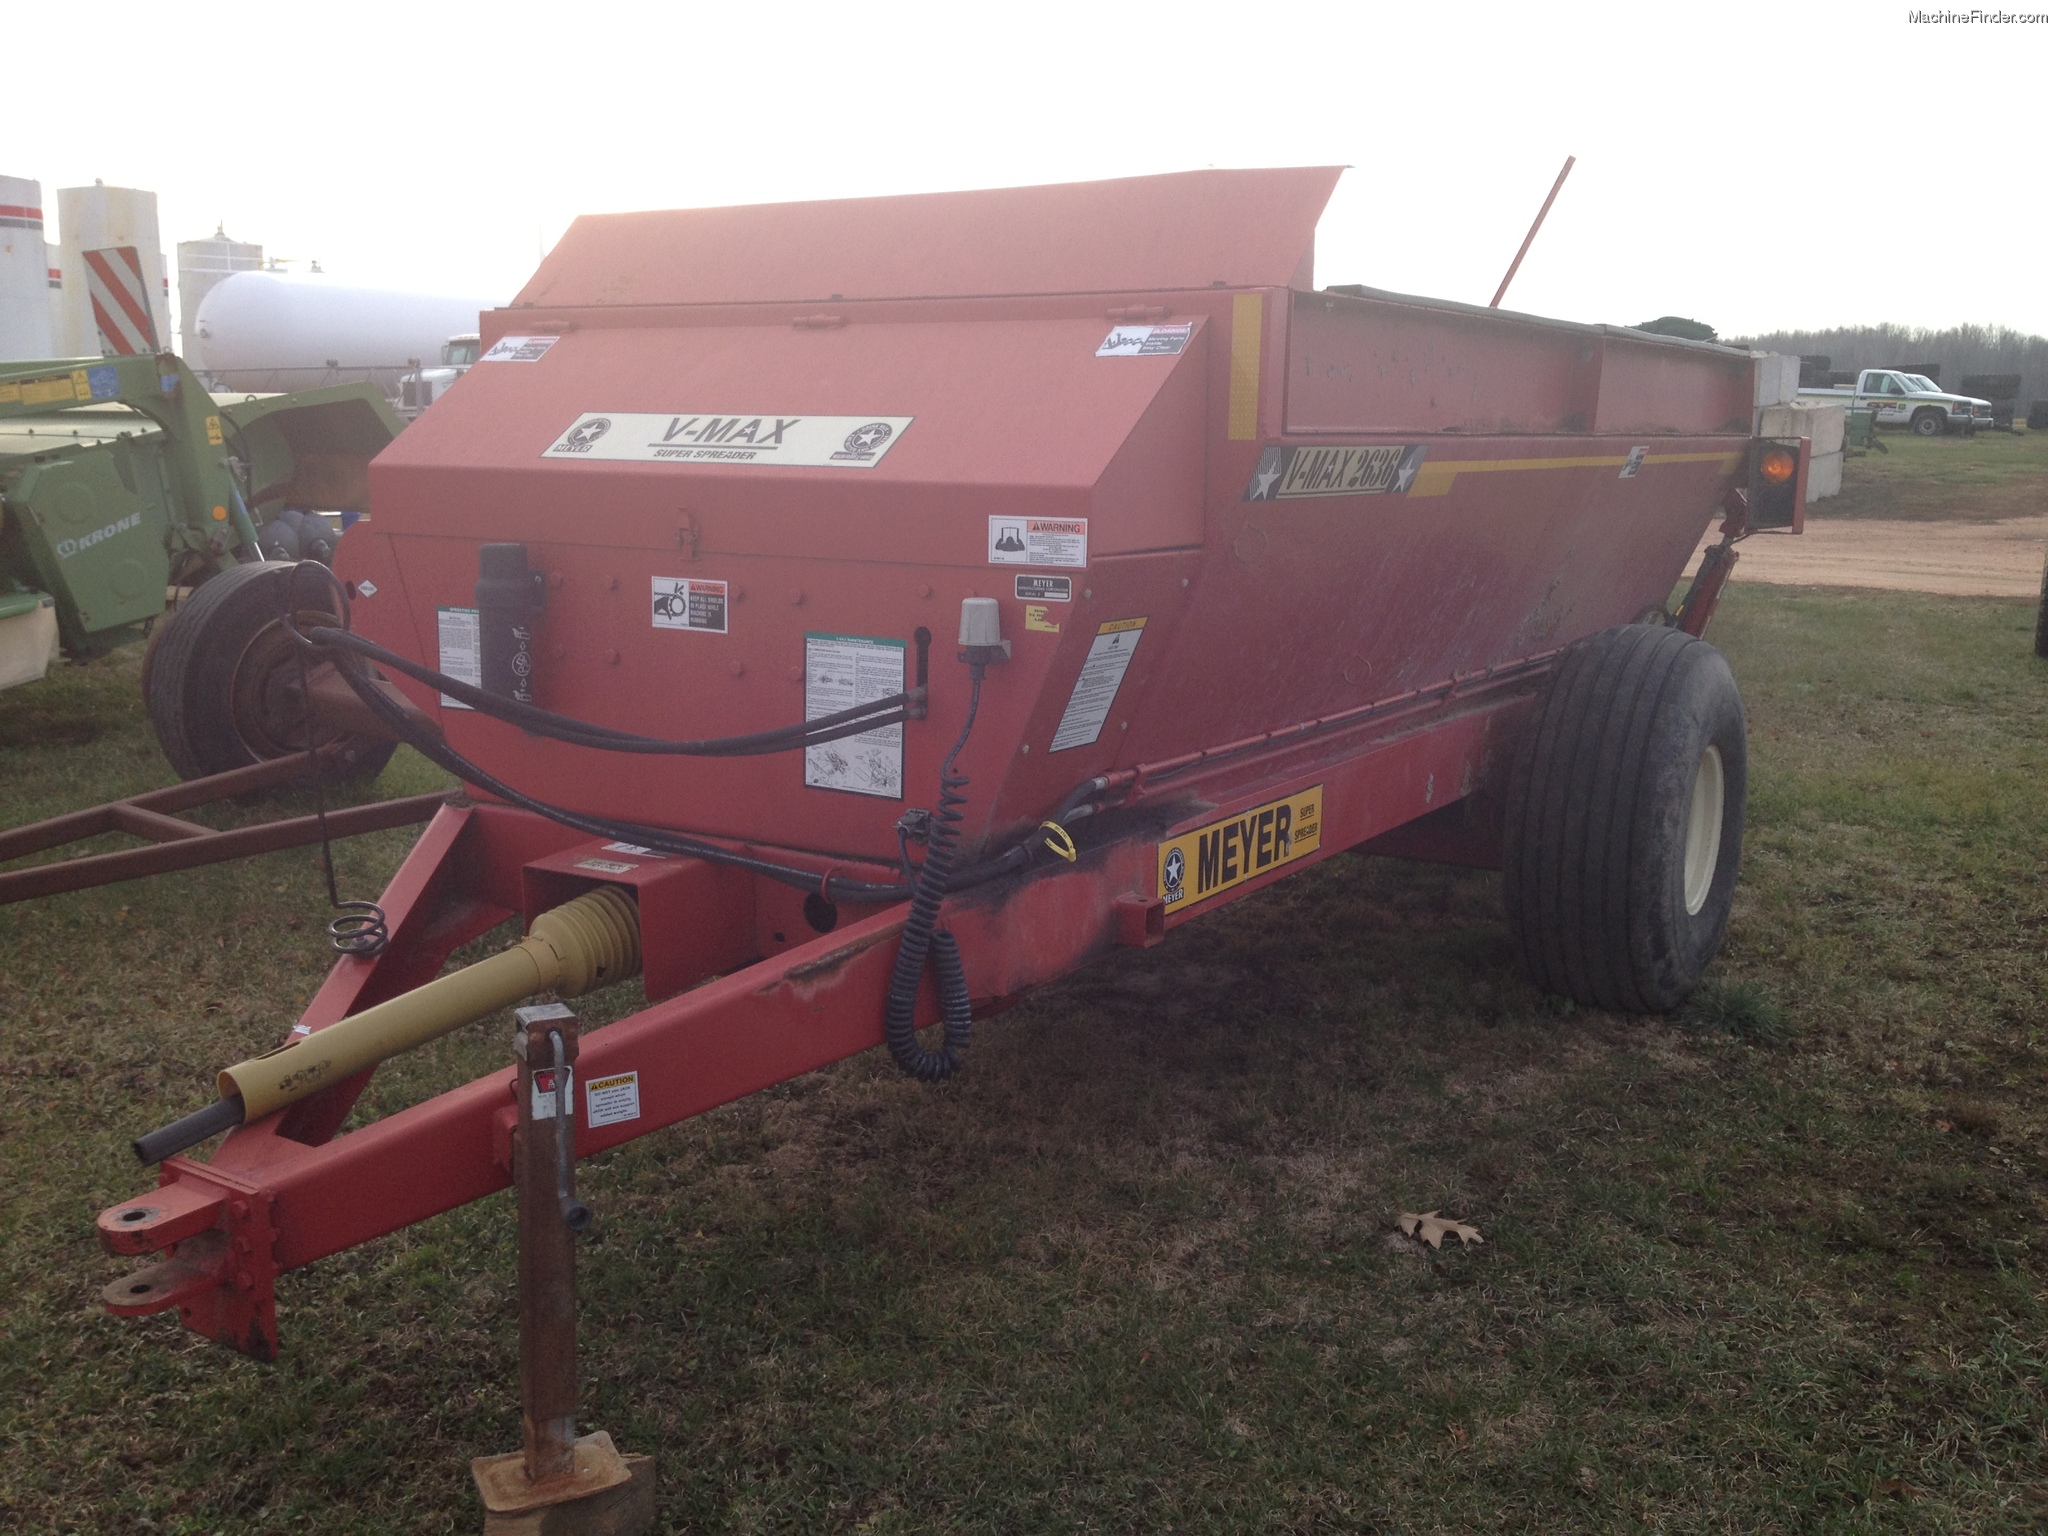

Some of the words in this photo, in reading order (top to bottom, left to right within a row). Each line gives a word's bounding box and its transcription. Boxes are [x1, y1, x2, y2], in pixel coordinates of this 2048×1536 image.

[663, 417, 801, 444] V-MAX
[654, 449, 694, 459] SUPER
[693, 451, 757, 460] SPREADER
[1286, 450, 1355, 490] V-MAX
[1347, 449, 1400, 488] 2636
[79, 512, 141, 551] KRONE
[1040, 522, 1081, 533] WARNING
[696, 584, 724, 594] WARNING
[1033, 579, 1054, 588] MEYER
[1108, 621, 1136, 632] CAUTION
[1300, 804, 1314, 818] SUPER
[1295, 822, 1317, 840] SPREADER
[1197, 804, 1291, 894] MEYER
[1163, 888, 1184, 904] MEYER
[598, 1075, 634, 1088] CAUTION
